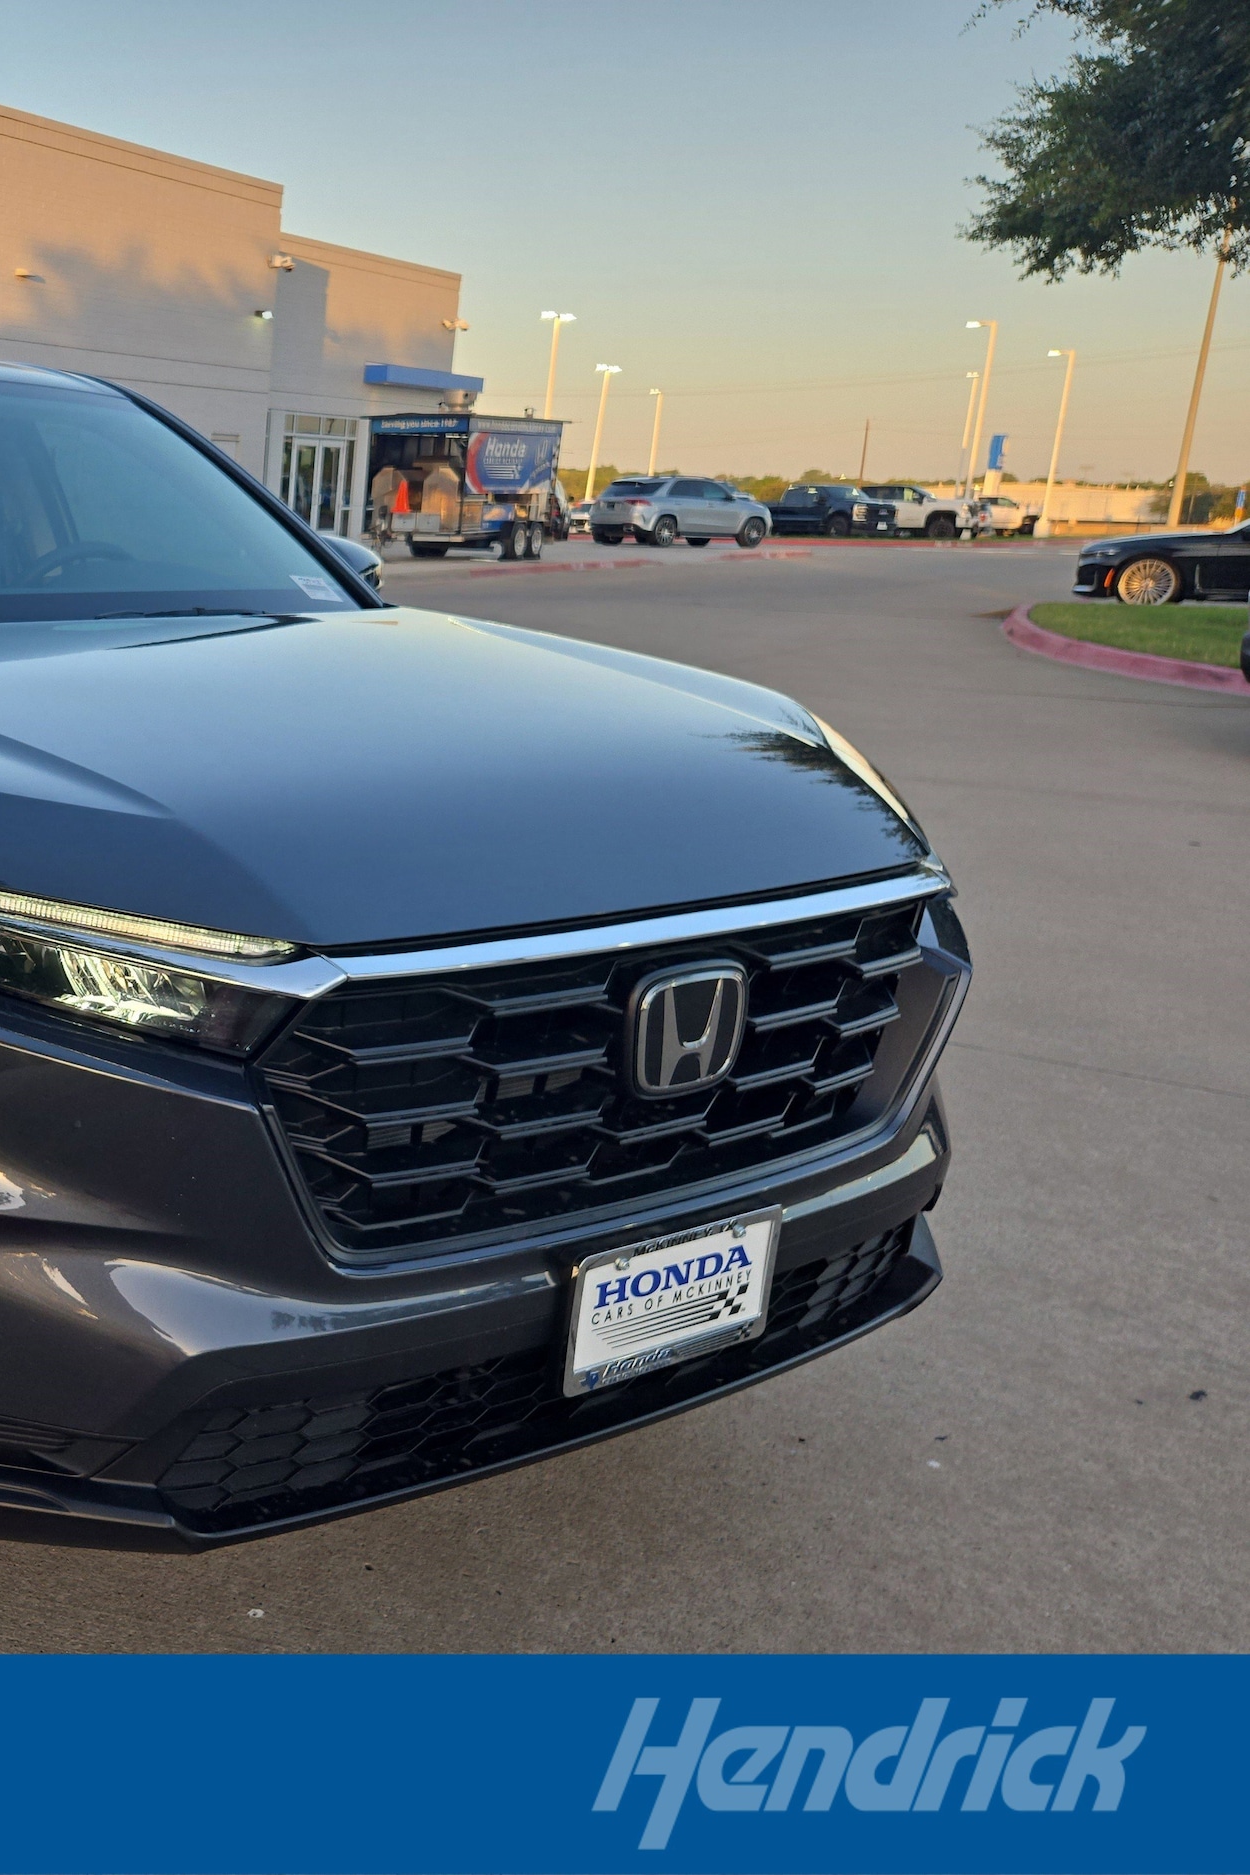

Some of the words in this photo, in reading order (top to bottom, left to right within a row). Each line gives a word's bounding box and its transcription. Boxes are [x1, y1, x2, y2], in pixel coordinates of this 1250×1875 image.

[485, 436, 527, 457] Honda
[591, 1303, 633, 1325] CARS
[644, 1295, 663, 1311] OF
[672, 1268, 752, 1304] MCKINNEY
[594, 1244, 752, 1309] HONDA
[602, 1346, 672, 1378] Honda
